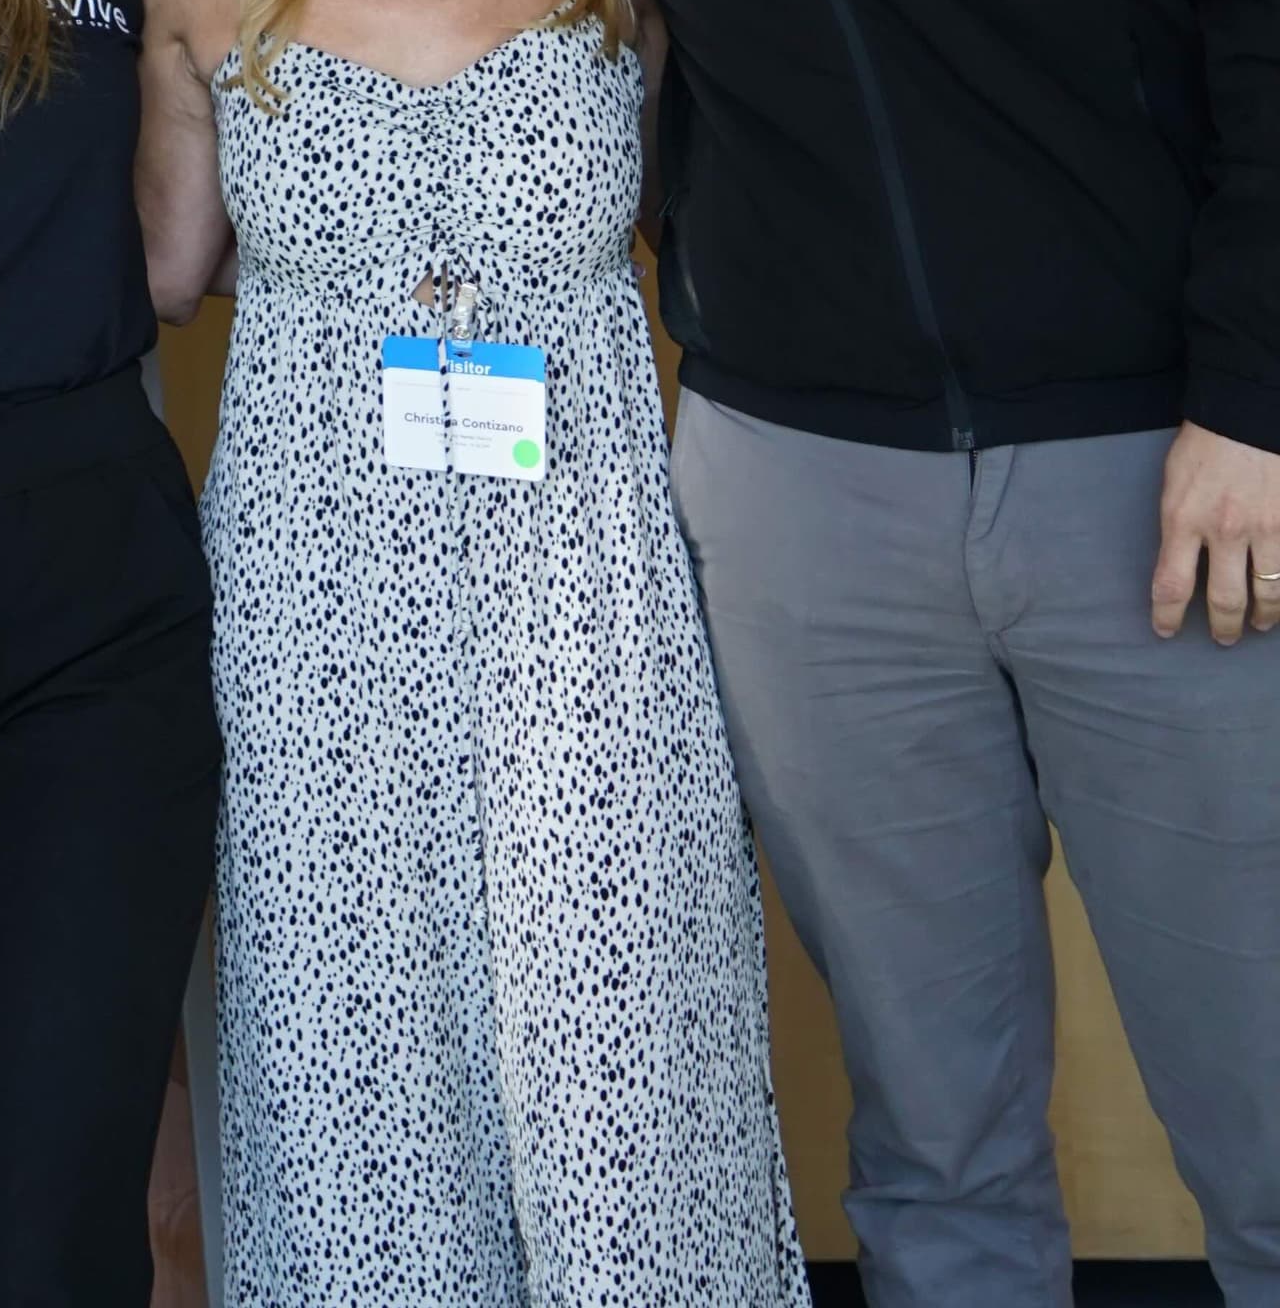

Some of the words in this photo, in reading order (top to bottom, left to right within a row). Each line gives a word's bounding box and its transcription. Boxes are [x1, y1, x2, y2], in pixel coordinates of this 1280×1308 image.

[445, 359, 491, 375] isitor
[404, 412, 458, 427] Christia
[462, 418, 524, 433] Contizano
